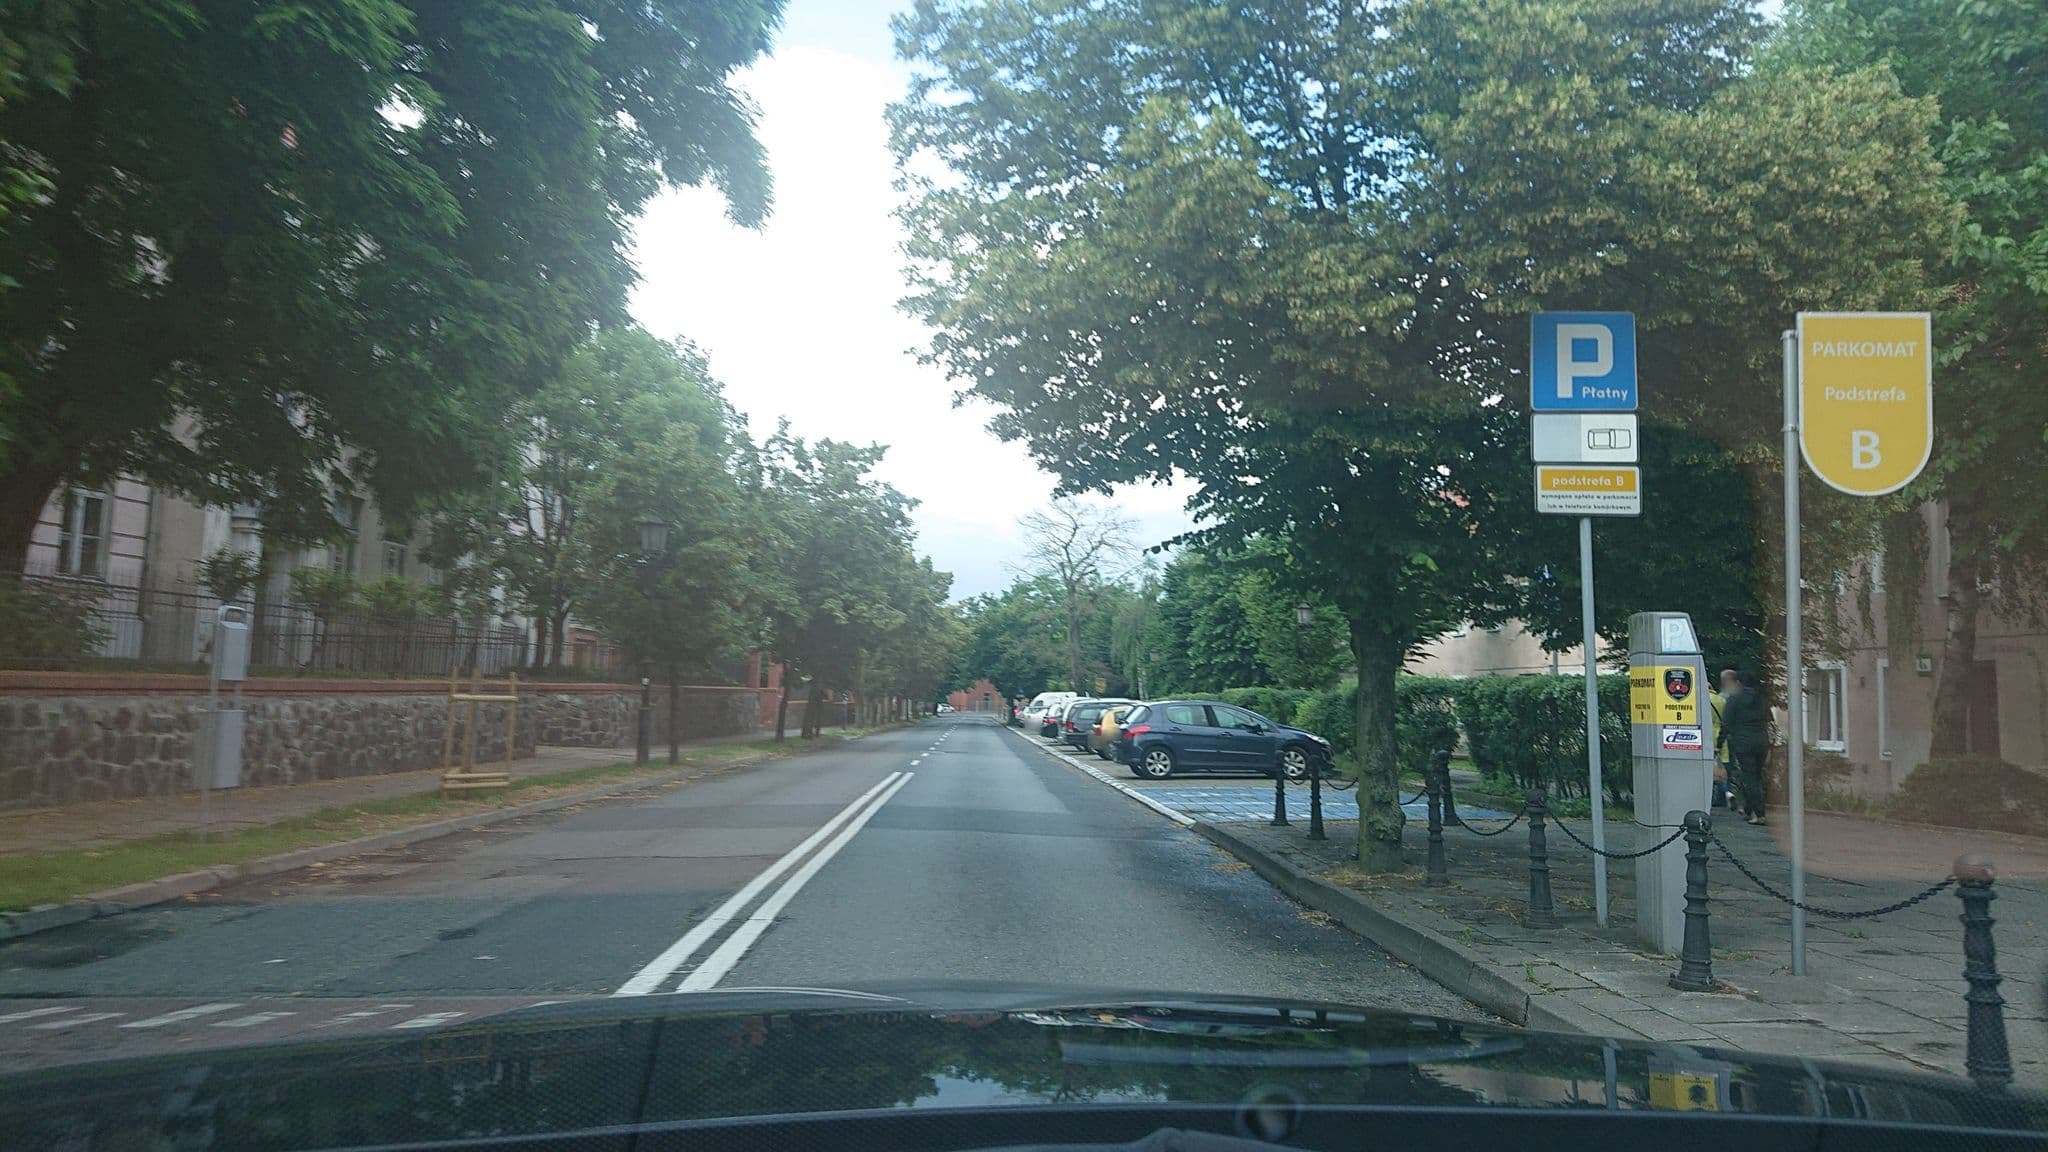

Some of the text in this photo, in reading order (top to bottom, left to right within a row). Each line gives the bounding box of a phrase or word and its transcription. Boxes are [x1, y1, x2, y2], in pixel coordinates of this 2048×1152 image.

[1812, 342, 1918, 357] PARKOMAT
[1557, 323, 1613, 398] P
[1582, 386, 1628, 400] Płatny
[1824, 386, 1906, 401] Podstrefa
[1851, 430, 1882, 469] B
[1552, 475, 1624, 487] podstrefa B
[1676, 711, 1682, 720] B
